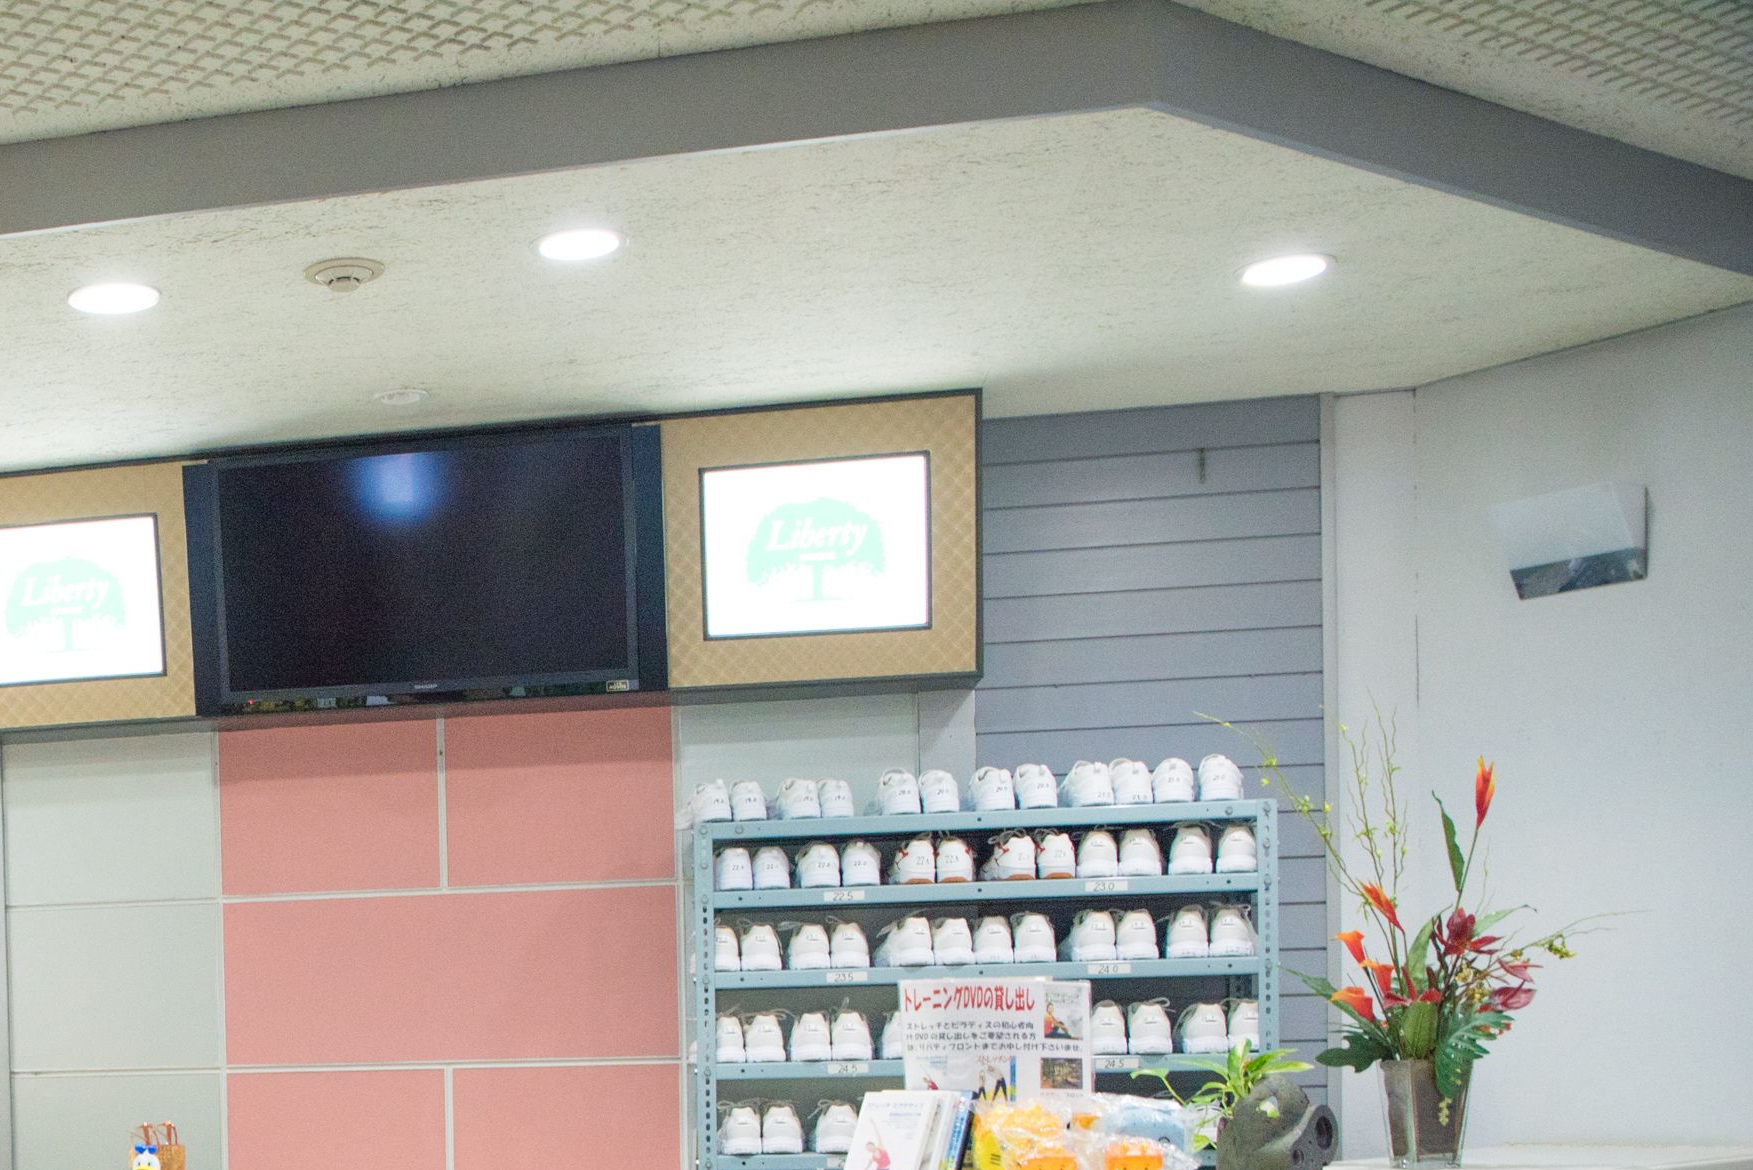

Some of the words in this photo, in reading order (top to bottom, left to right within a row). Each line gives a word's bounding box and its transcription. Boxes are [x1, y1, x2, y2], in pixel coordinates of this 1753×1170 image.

[765, 516, 868, 555] Liberty
[21, 573, 110, 609] Liberty
[904, 985, 1035, 1012] トレーニングDVDの貸し出し
